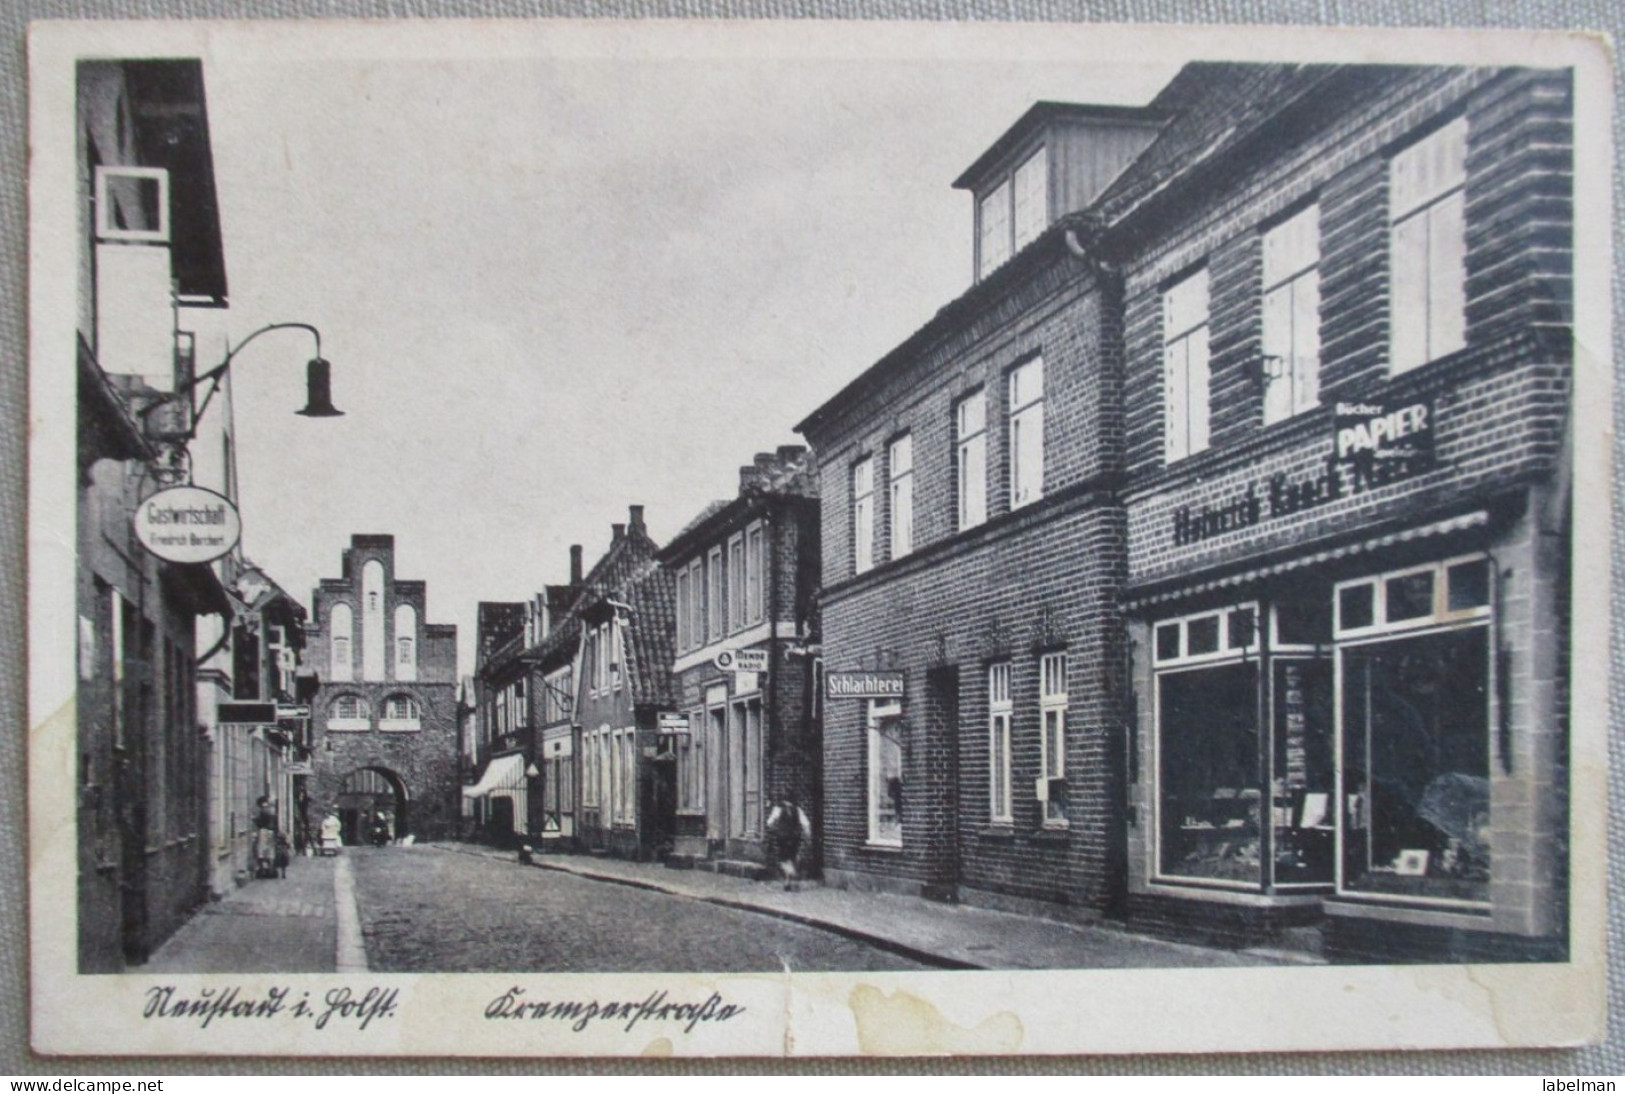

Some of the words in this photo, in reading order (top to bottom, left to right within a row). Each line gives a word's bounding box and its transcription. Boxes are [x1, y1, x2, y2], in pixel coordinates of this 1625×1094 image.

[1335, 401, 1384, 416] Bücher
[1337, 403, 1429, 458] PAPIER
[147, 502, 226, 525] Gastwirtschaft
[1172, 479, 1260, 547] Heinrich
[150, 531, 187, 546] Friedrich
[738, 662, 762, 670] RADIO
[828, 673, 904, 694] Schlachterei
[144, 986, 288, 1027] Neustadt
[293, 990, 314, 1019] i.
[318, 987, 399, 1032] Holst.
[485, 986, 746, 1033] Kremperstraße
